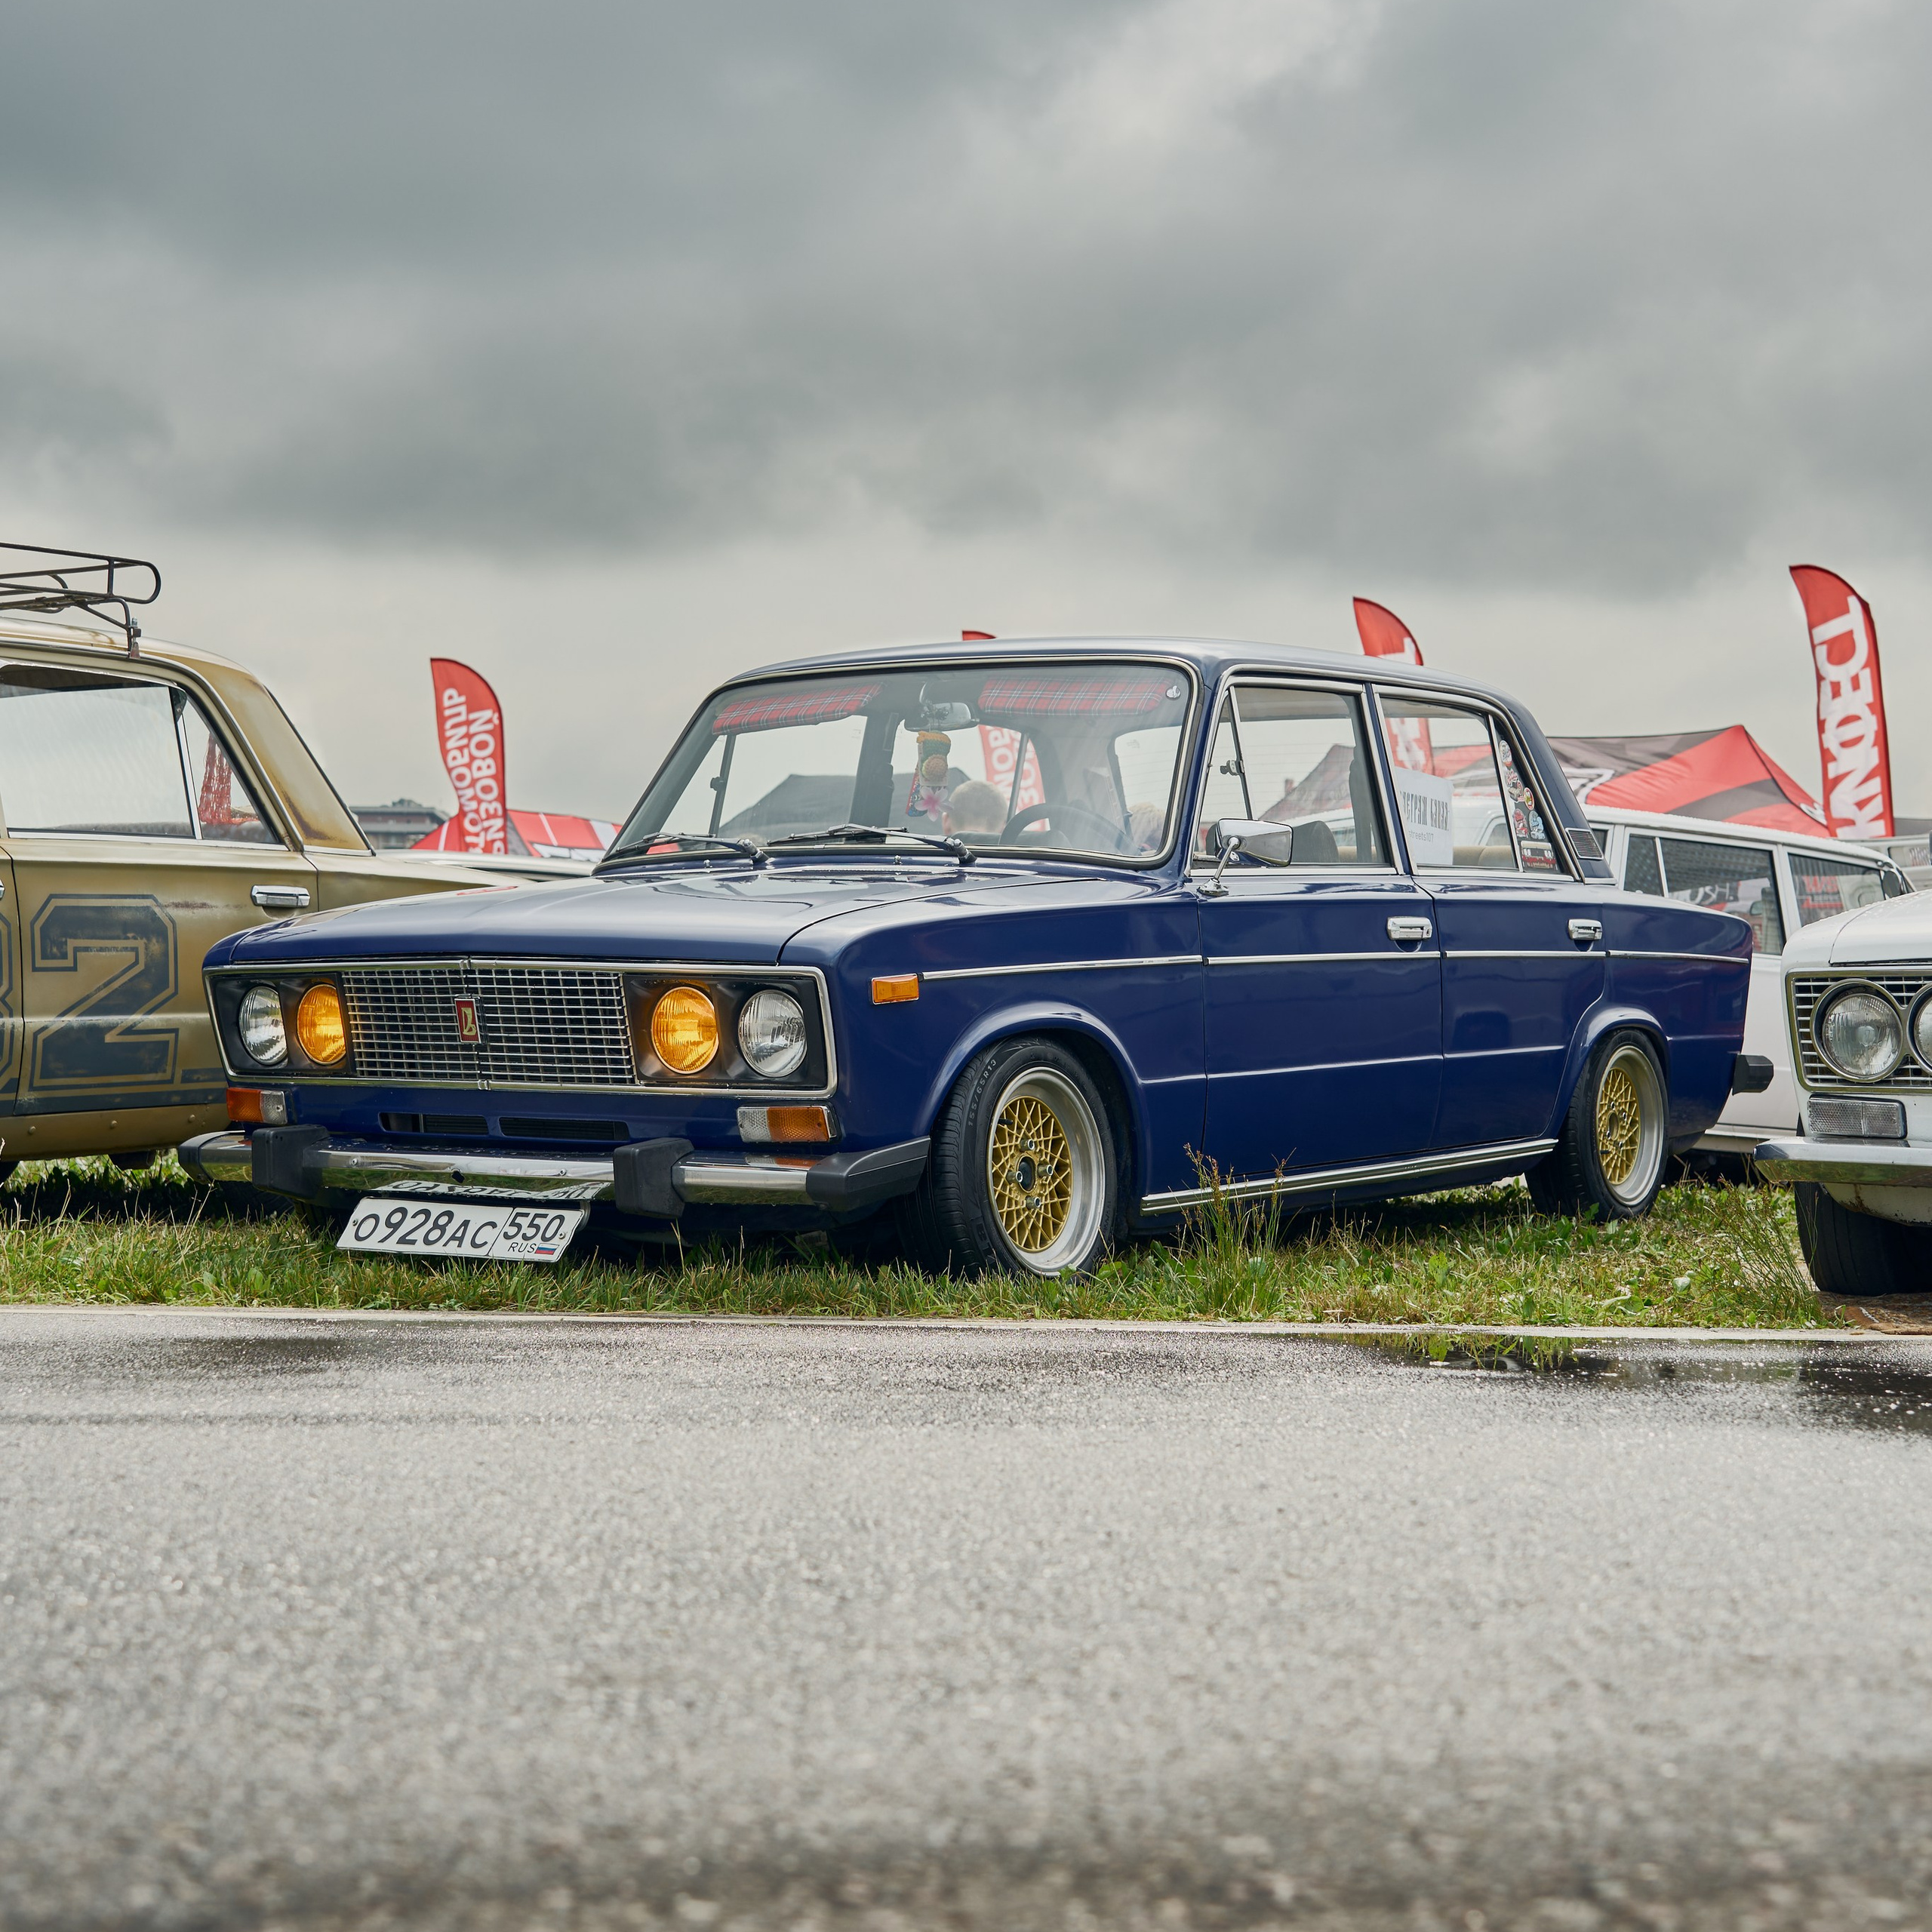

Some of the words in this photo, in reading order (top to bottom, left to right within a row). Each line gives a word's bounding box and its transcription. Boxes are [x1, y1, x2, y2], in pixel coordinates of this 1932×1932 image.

[0, 894, 179, 1092] 2
[968, 1059, 997, 1127] 155/65R13
[503, 1211, 566, 1242] 550
[508, 1241, 537, 1254] RUS
